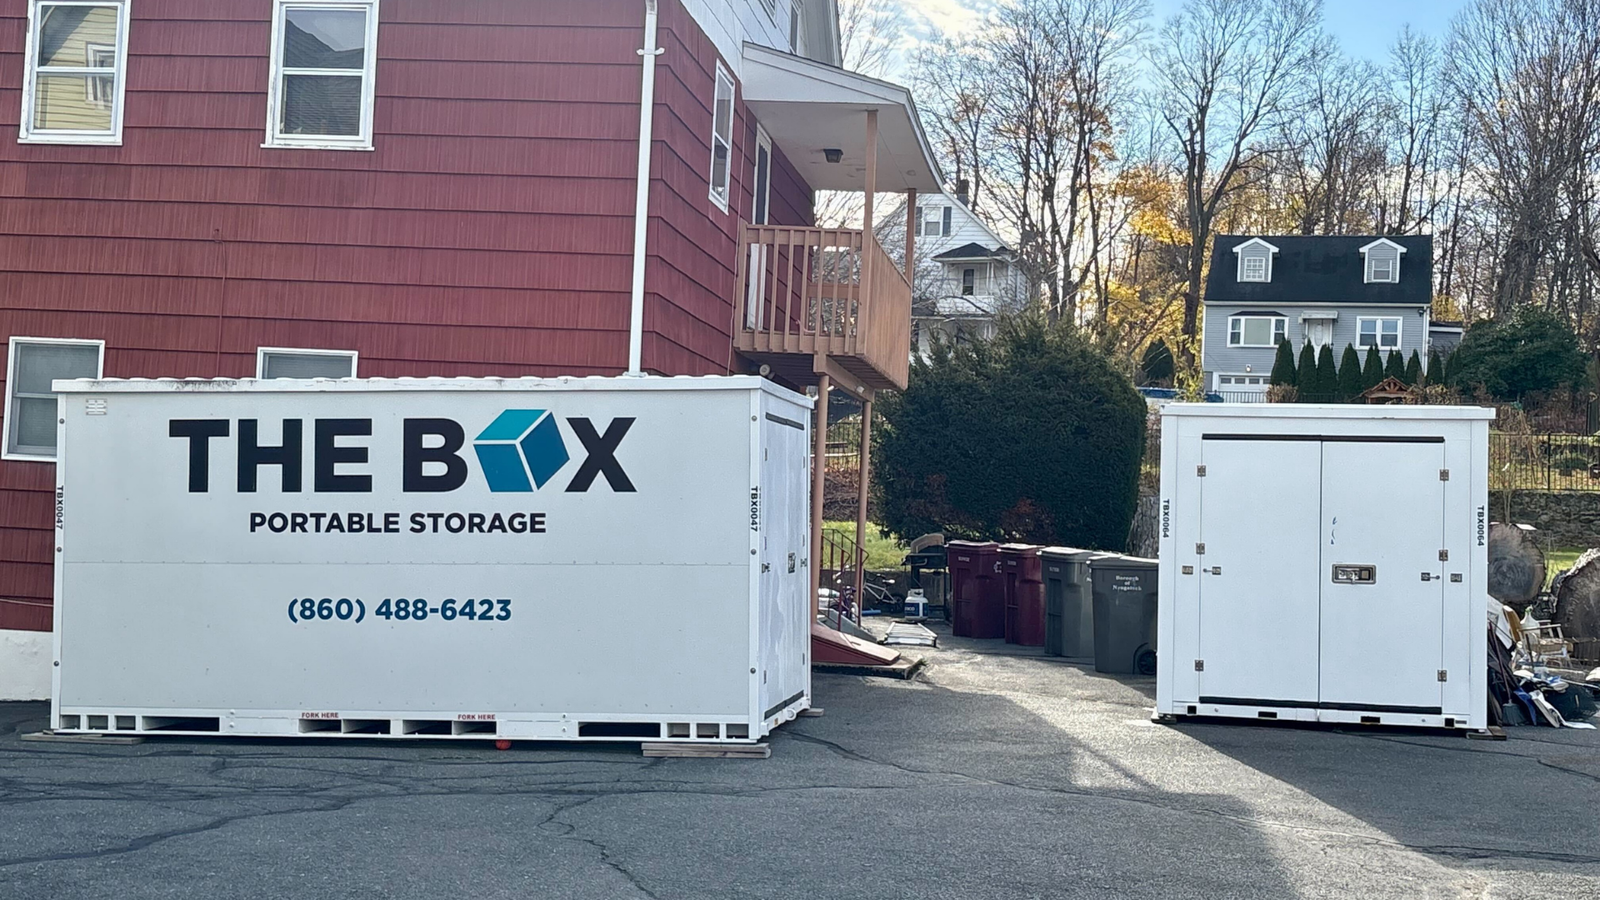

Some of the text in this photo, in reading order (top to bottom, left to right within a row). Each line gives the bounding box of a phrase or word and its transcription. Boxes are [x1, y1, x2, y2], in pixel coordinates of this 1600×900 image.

[169, 418, 373, 493] THE
[56, 485, 64, 530] TBX0047
[250, 512, 547, 534] PORTABLE STORAGE
[750, 485, 758, 532] TBX0047
[1162, 498, 1170, 538] TBX0064
[1477, 505, 1485, 546] TBX0064
[288, 597, 512, 624] (860) 488-6423
